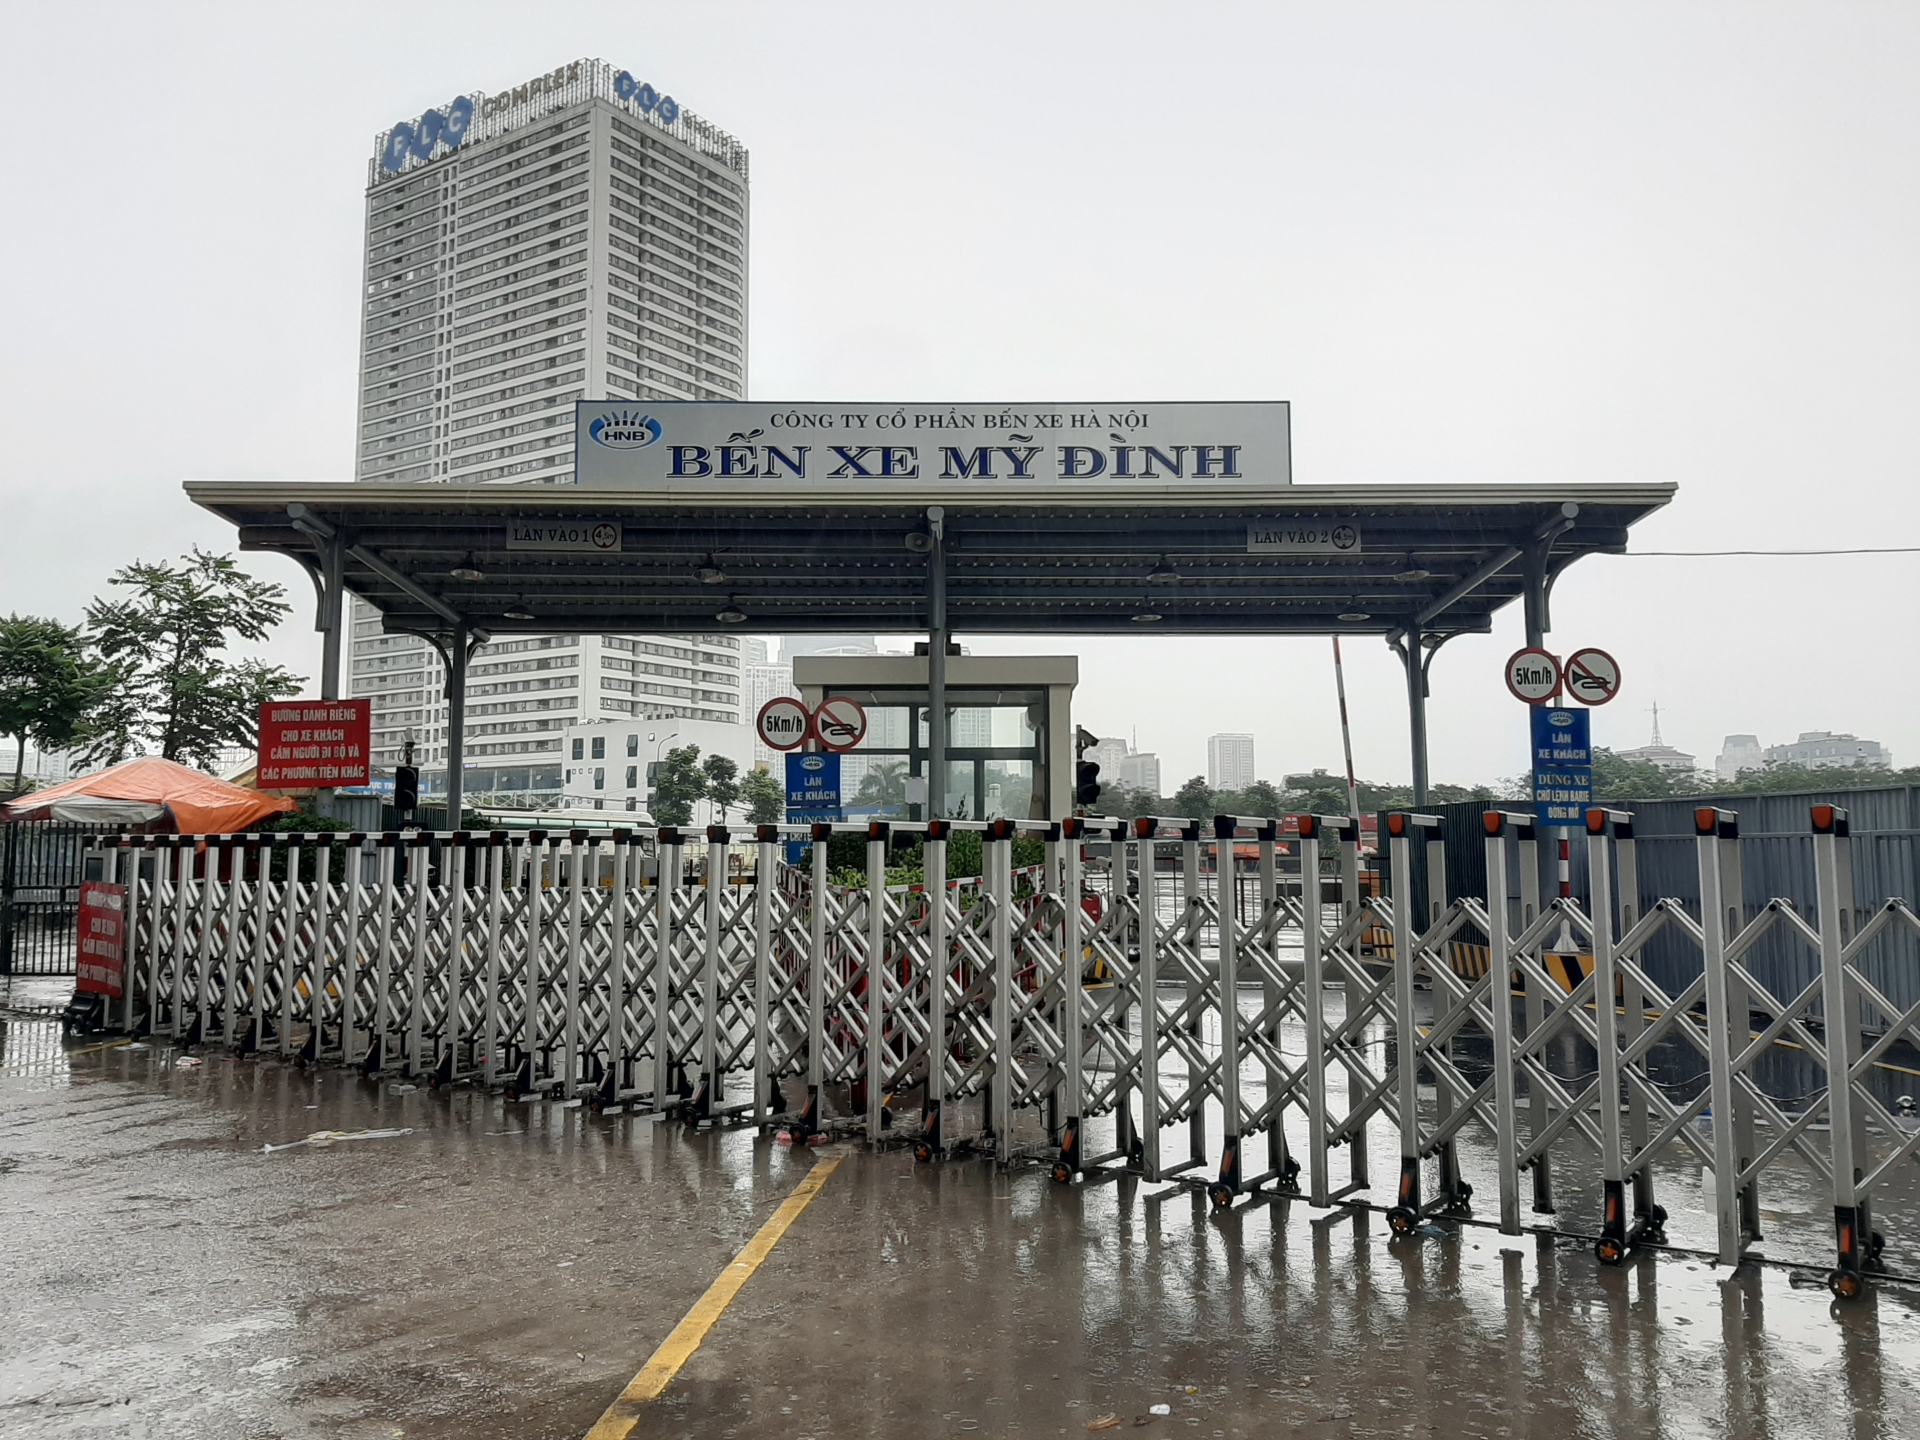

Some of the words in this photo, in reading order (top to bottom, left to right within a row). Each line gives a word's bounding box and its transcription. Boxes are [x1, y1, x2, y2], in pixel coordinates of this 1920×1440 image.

[481, 60, 579, 119] COMPLEX
[770, 410, 834, 429] CÔNG
[841, 414, 869, 429] TY
[876, 407, 906, 429] CỔ
[913, 407, 976, 429] PHẦN
[983, 407, 1028, 429] BẾN
[1034, 414, 1063, 429] XE
[1070, 409, 1102, 428] HÀ
[1108, 409, 1149, 432] NỘI
[604, 431, 646, 442] HNB
[666, 428, 811, 479] BẾN
[826, 445, 919, 479] XE
[938, 433, 1044, 479] MỸ
[1058, 433, 1242, 479] ĐÌNH
[513, 525, 543, 541] LÀN
[548, 525, 579, 542] VÀO
[582, 529, 589, 542] 1
[1254, 528, 1283, 544] LÀN
[1288, 528, 1317, 544] VÀO
[1320, 530, 1328, 543] 2
[1516, 667, 1552, 685] 5Km/h
[766, 715, 803, 733] 5Km/h
[281, 729, 299, 742] CHO
[301, 729, 312, 742] XE
[314, 727, 344, 741] KHÁCH
[321, 746, 332, 758] ĐI
[348, 743, 360, 758] VÀ
[1538, 748, 1551, 759] XE
[1553, 746, 1587, 760] KHÁCH
[261, 765, 279, 780] CÁC
[341, 764, 365, 778] KHÁC
[1574, 774, 1589, 786] XE
[791, 791, 803, 801] XE
[805, 788, 836, 801] KHÁCH
